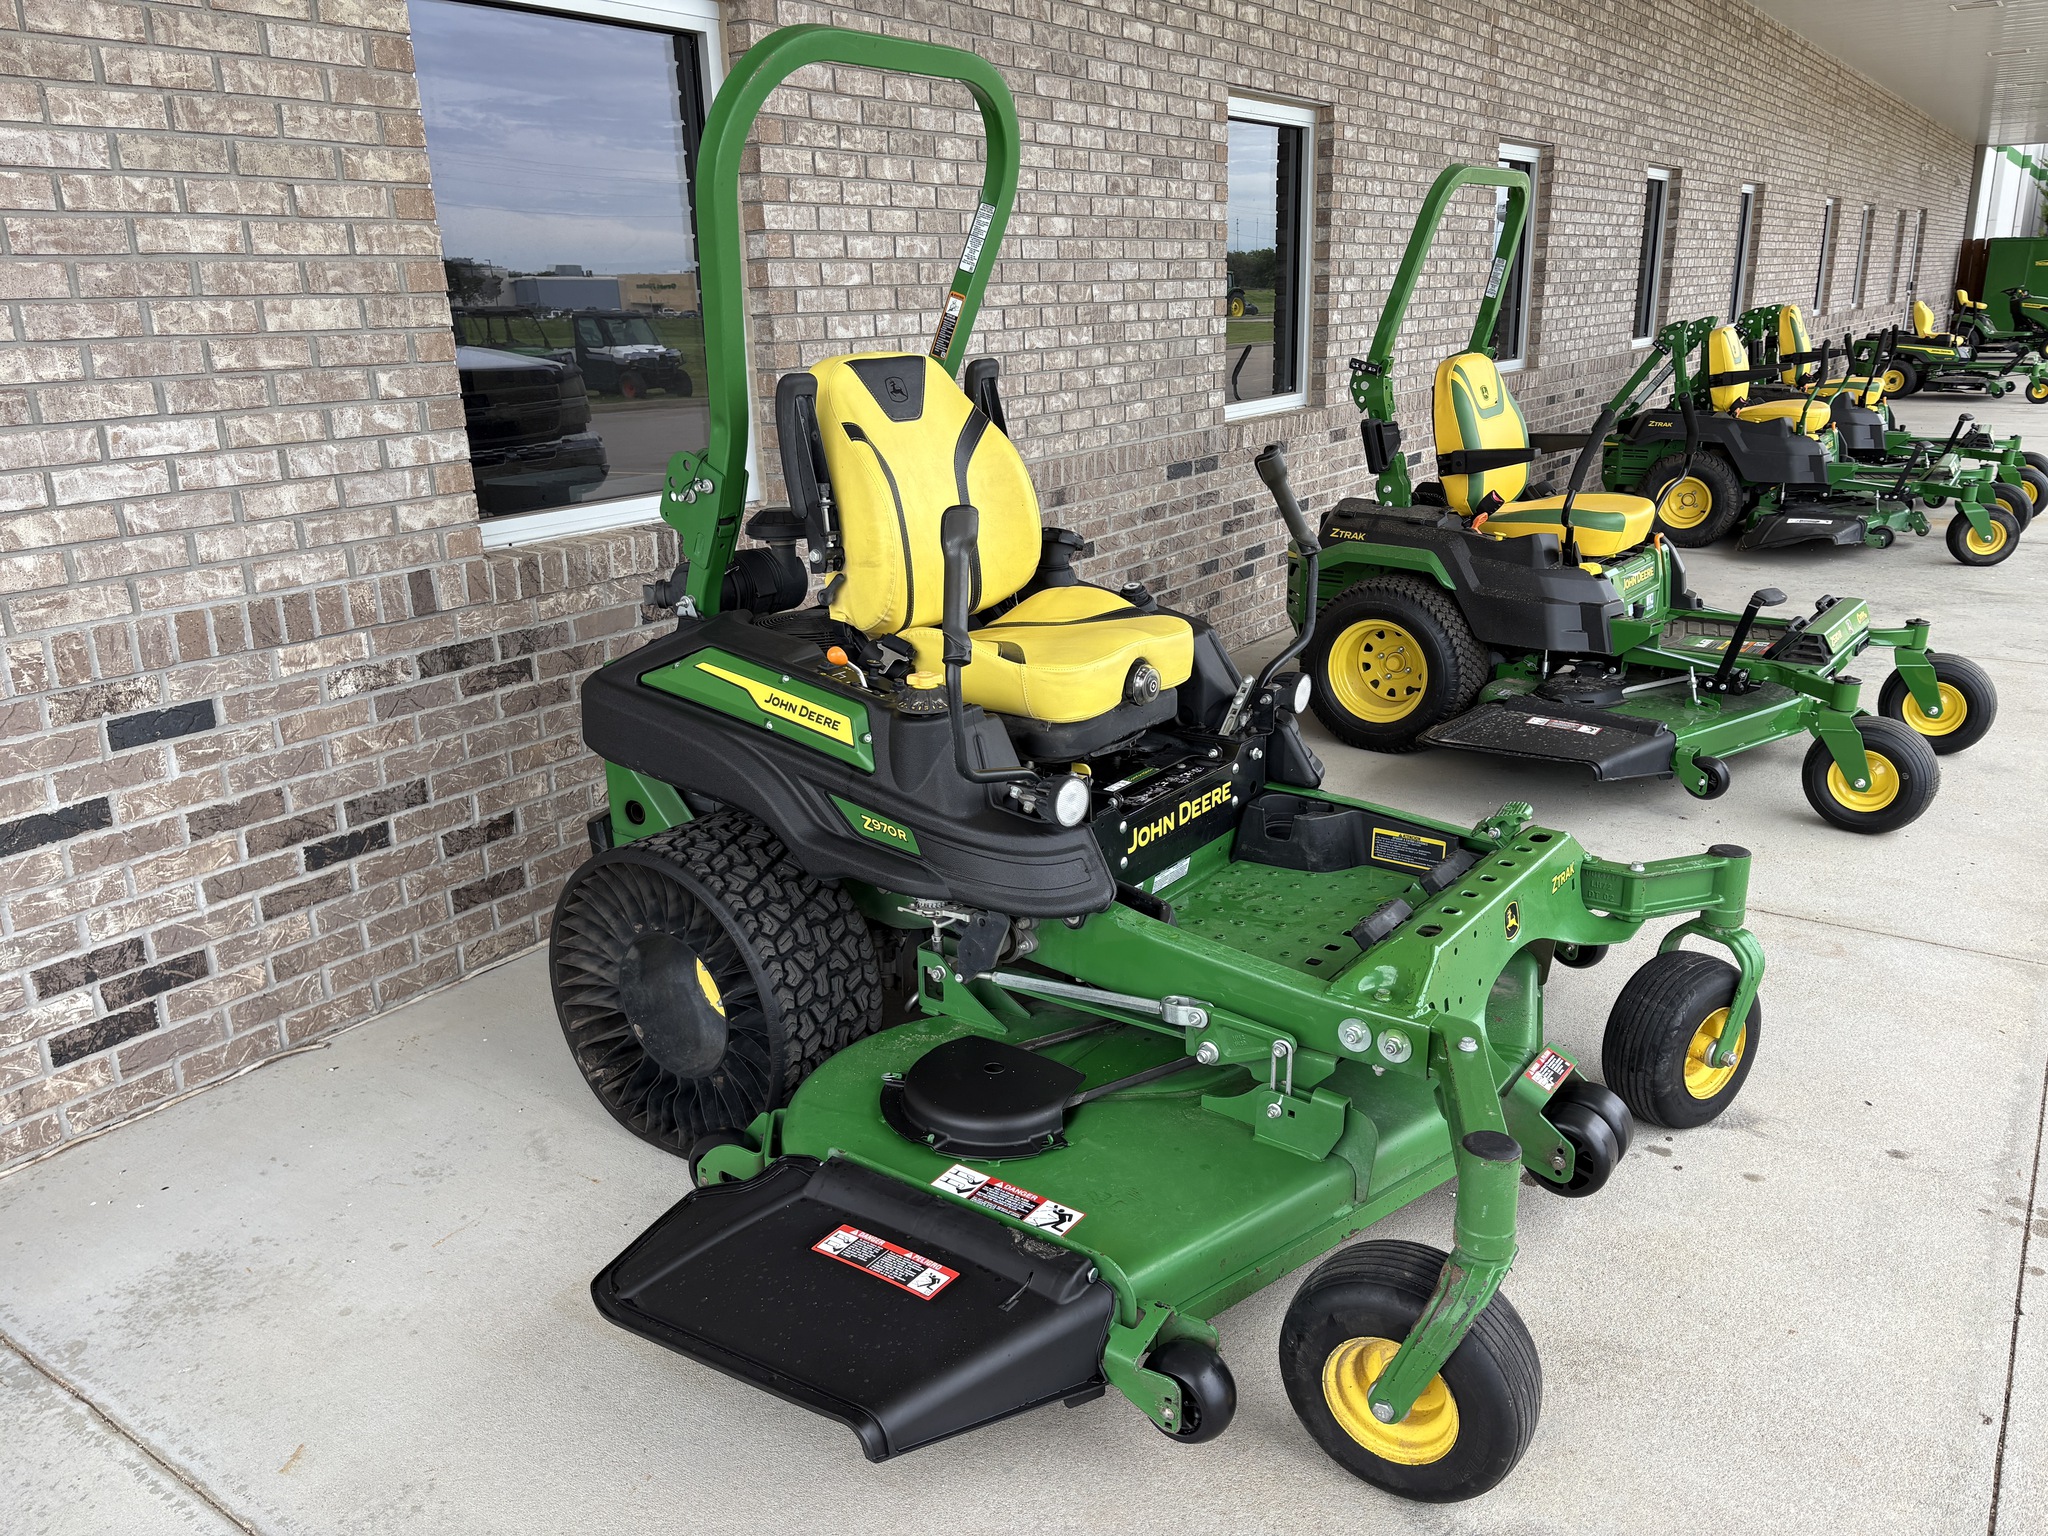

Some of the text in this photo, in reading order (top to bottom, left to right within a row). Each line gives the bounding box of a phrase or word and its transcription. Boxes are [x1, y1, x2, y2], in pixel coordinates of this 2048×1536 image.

[1648, 420, 1673, 428] ZTRAK
[1330, 527, 1366, 541] ZTRAK
[764, 692, 840, 731] JOHN DEERE
[1127, 811, 1176, 855] JOHN
[1178, 780, 1232, 827] DEERE
[861, 815, 907, 842] Z970R
[1552, 861, 1575, 895] ZTRAK
[1004, 1183, 1039, 1201] DANGER
[858, 1231, 886, 1247] DANGER
[912, 1253, 943, 1271] PELIGRO
